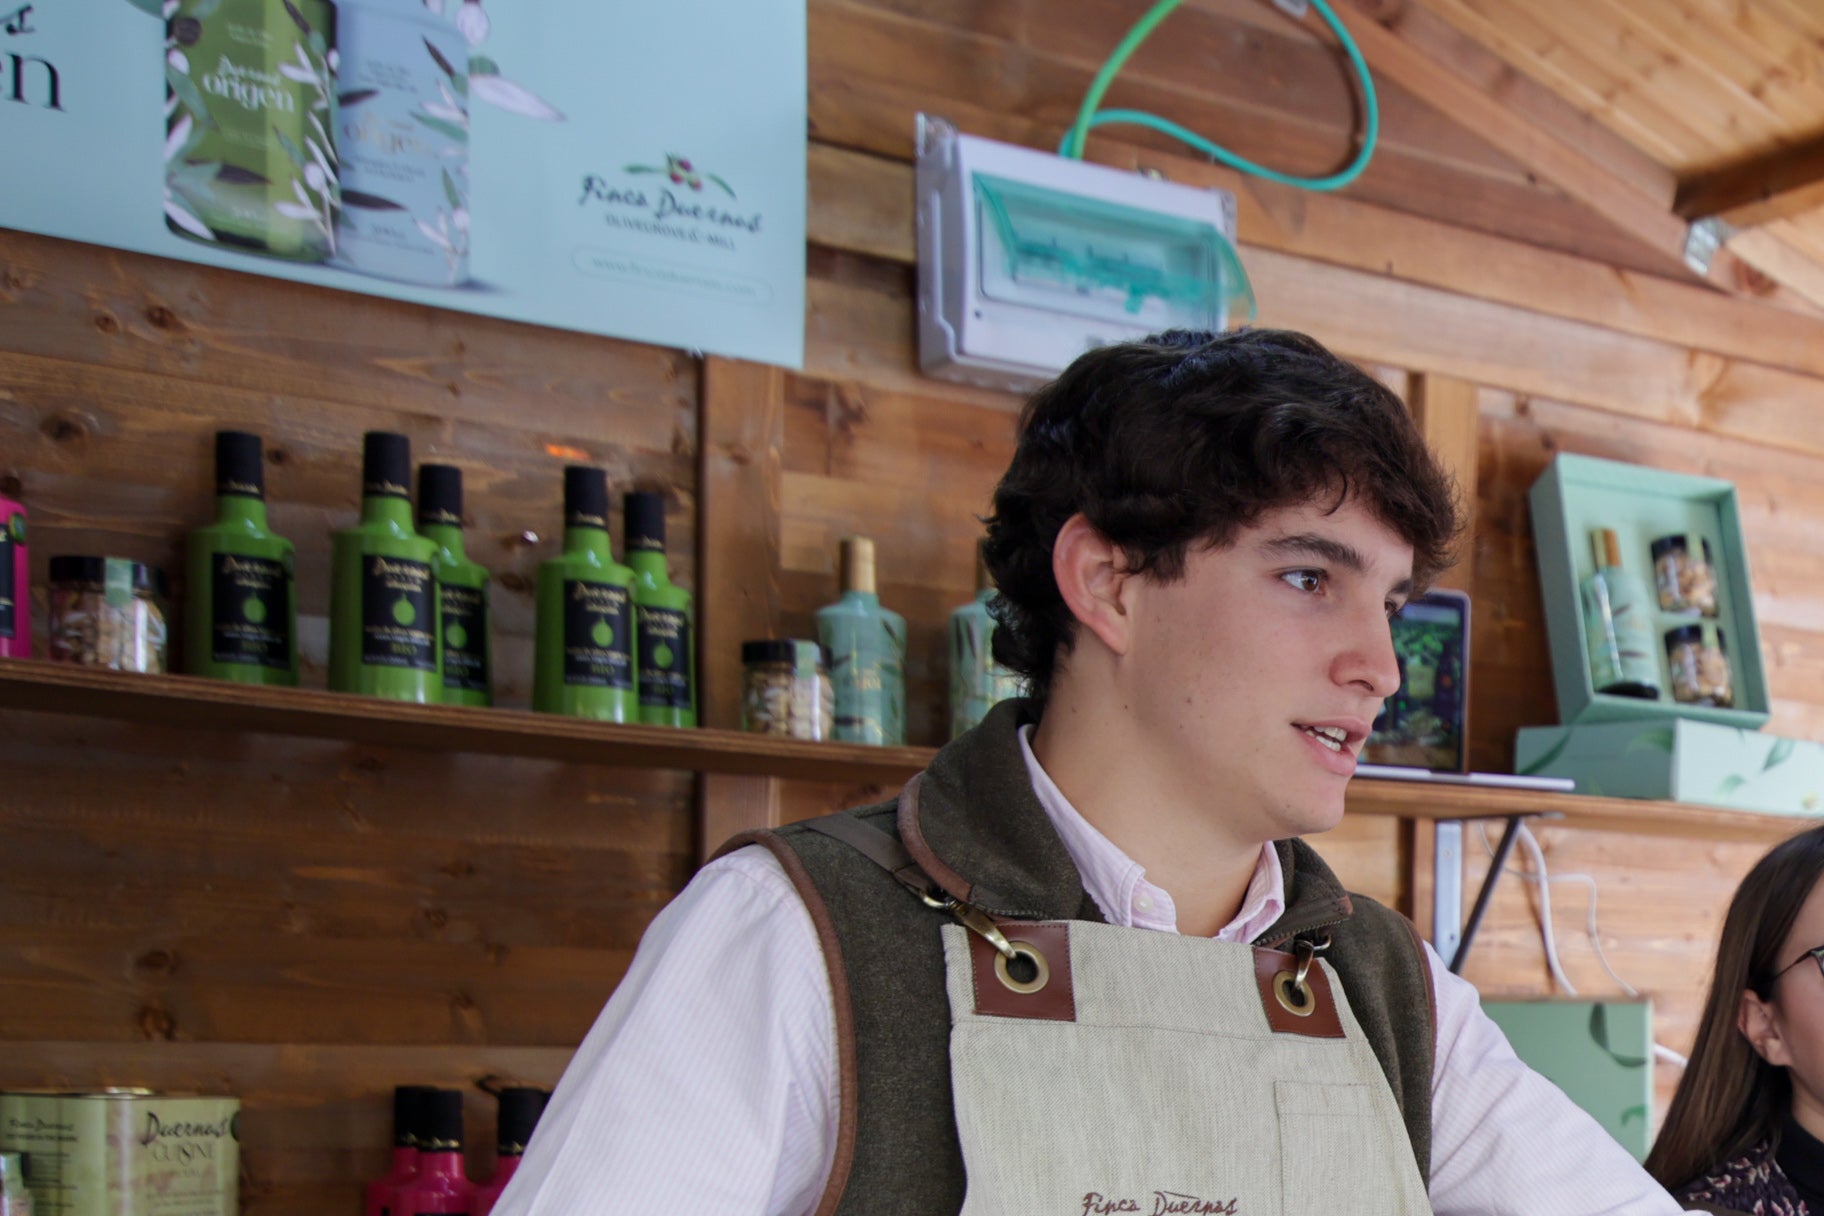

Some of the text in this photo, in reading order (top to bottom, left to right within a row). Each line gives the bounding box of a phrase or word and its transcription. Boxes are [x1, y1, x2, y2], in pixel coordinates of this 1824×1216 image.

[202, 73, 295, 113] origen
[579, 173, 649, 208] Finca
[141, 1109, 230, 1147] Duernas
